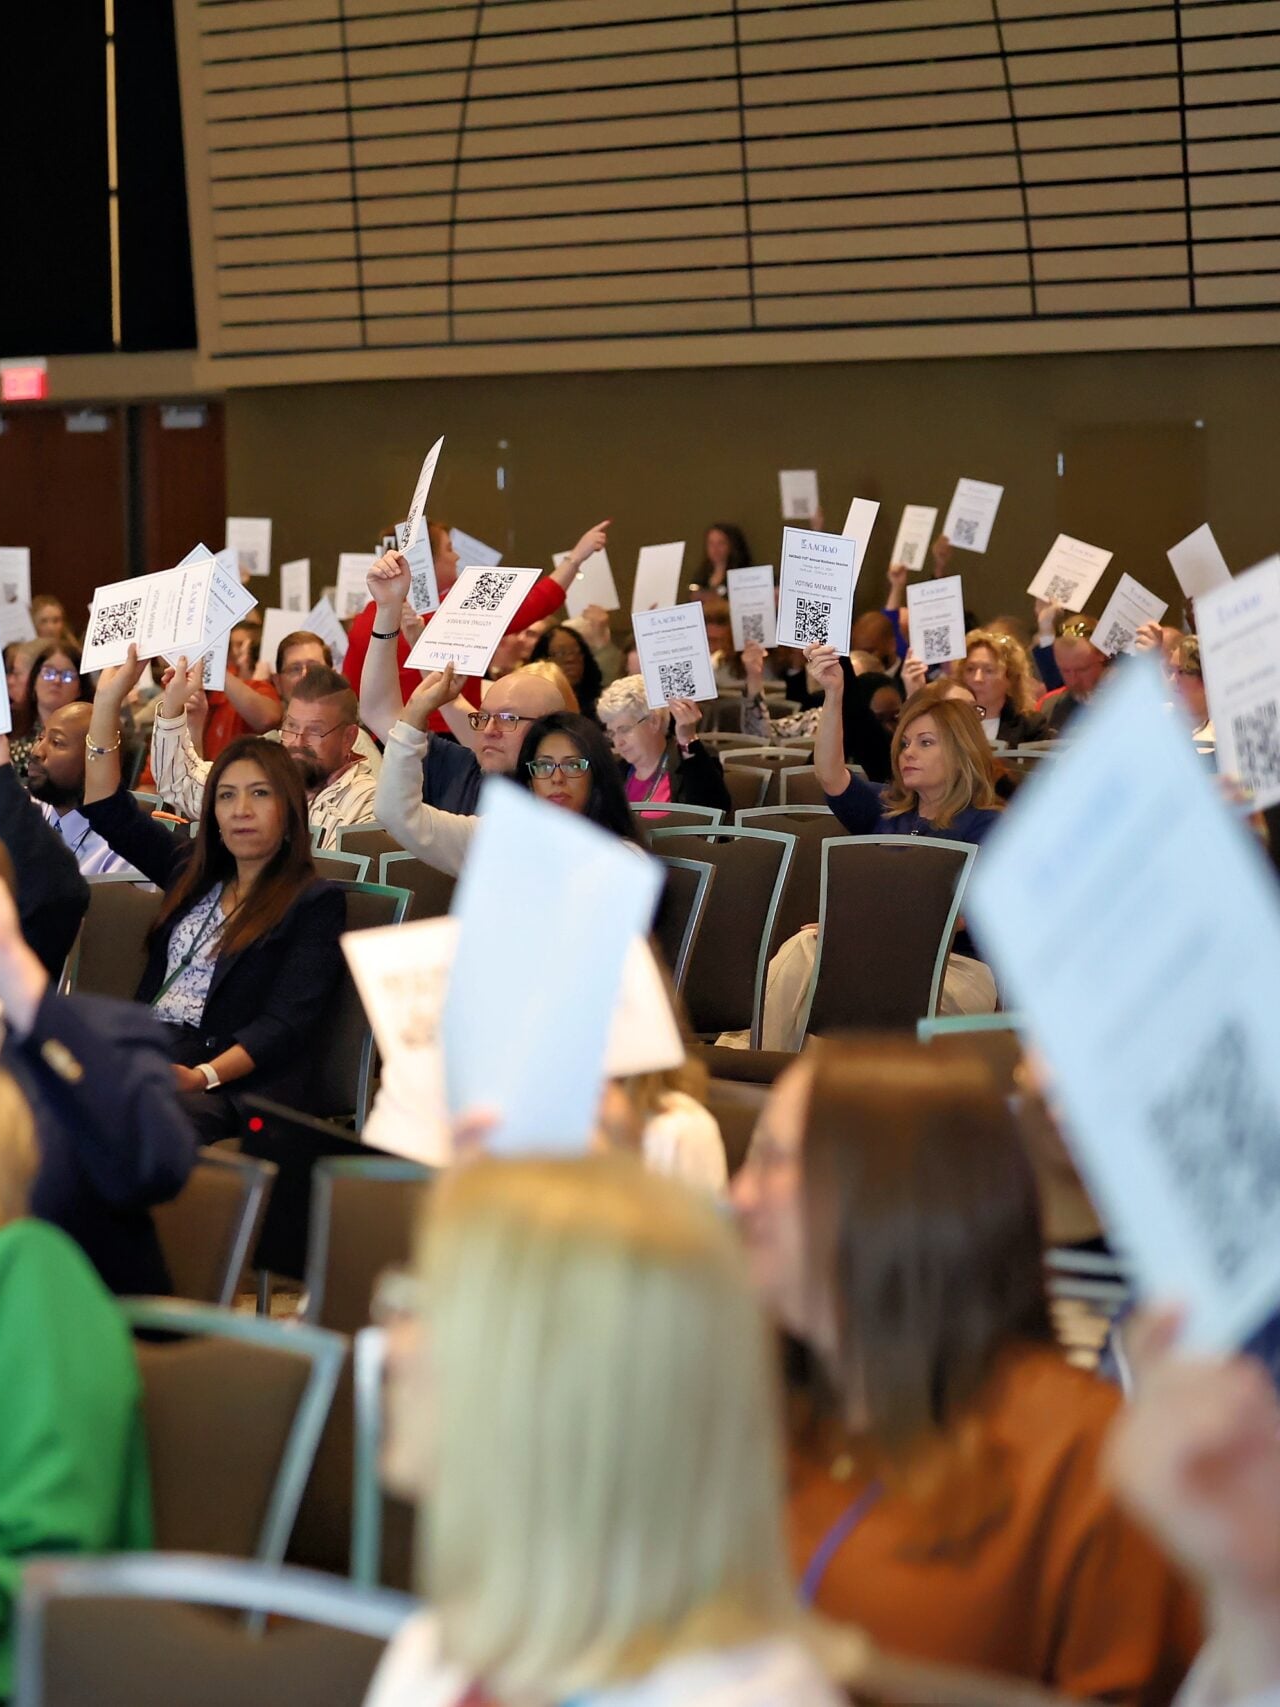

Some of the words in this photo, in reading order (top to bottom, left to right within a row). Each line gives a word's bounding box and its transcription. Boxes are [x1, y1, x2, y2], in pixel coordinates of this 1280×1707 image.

[808, 543, 838, 554] AACRAO
[795, 580, 813, 589] VOTING
[814, 583, 837, 592] MEMBER
